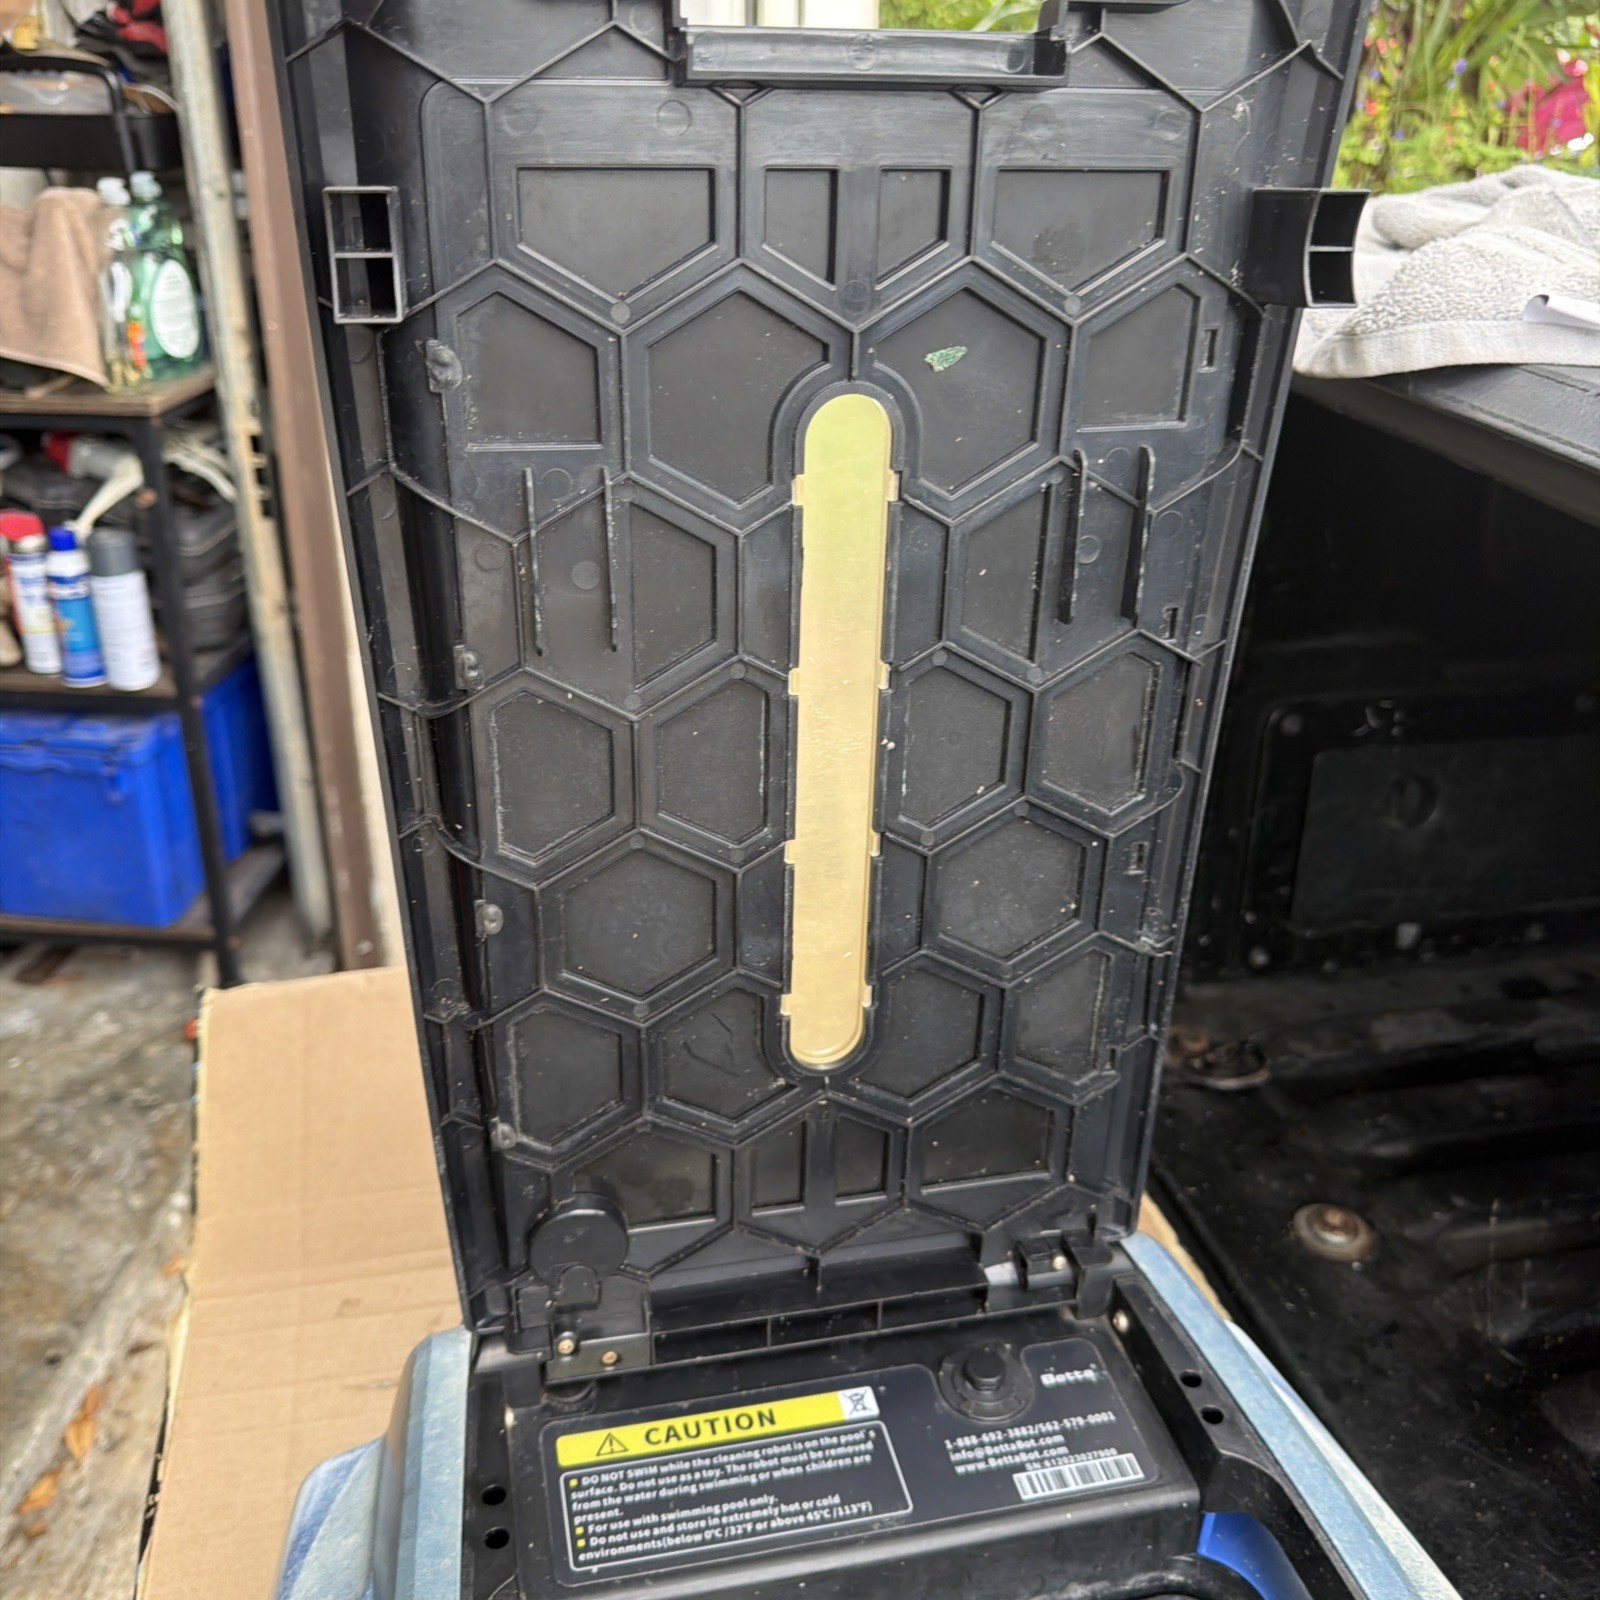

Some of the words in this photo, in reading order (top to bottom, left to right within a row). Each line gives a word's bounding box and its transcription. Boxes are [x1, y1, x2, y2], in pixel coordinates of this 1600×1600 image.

[644, 1408, 777, 1446] CAUTION
[581, 1474, 598, 1485] DO
[600, 1470, 624, 1482] NOT
[626, 1465, 658, 1477] SWIM
[659, 1459, 690, 1472] while
[692, 1456, 711, 1467] the
[712, 1448, 760, 1465] cleaning
[761, 1442, 792, 1456] robot
[793, 1440, 802, 1450] is
[804, 1439, 818, 1448] on
[819, 1434, 838, 1445] the
[949, 1434, 1066, 1461] info@BettaBot.com
[954, 1445, 1070, 1474] www.BettaBot.com
[570, 1483, 617, 1499] surface.
[618, 1480, 635, 1491] Do
[636, 1477, 657, 1488] not
[658, 1475, 678, 1485] use
[679, 1472, 692, 1481] as
[702, 1467, 724, 1479] toy.
[724, 1462, 746, 1474] The
[748, 1456, 778, 1470] robot
[780, 1452, 808, 1464] must
[808, 1449, 823, 1459] be
[824, 1440, 874, 1457] removed
[571, 1497, 601, 1511] from
[602, 1495, 622, 1506] the
[623, 1489, 656, 1502] water
[658, 1484, 698, 1498] during
[698, 1472, 758, 1491] swimming
[758, 1471, 770, 1480] or
[772, 1464, 803, 1477] when
[805, 1456, 852, 1472] children
[853, 1454, 872, 1464] are
[573, 1507, 624, 1525] present.
[588, 1522, 608, 1533] For
[609, 1519, 630, 1530] use
[632, 1513, 658, 1526] with
[660, 1503, 720, 1523] swimming
[721, 1498, 748, 1513] pool
[749, 1494, 778, 1508] only.
[589, 1535, 606, 1546] Do
[607, 1532, 628, 1543] not
[630, 1529, 650, 1539] use
[652, 1523, 674, 1535] and
[676, 1519, 706, 1531] store
[708, 1515, 720, 1525] in
[721, 1506, 778, 1524] extremely
[780, 1501, 800, 1513] hot
[801, 1501, 814, 1510] or
[815, 1494, 840, 1507] cold
[755, 1521, 768, 1530] or
[770, 1514, 805, 1528] above
